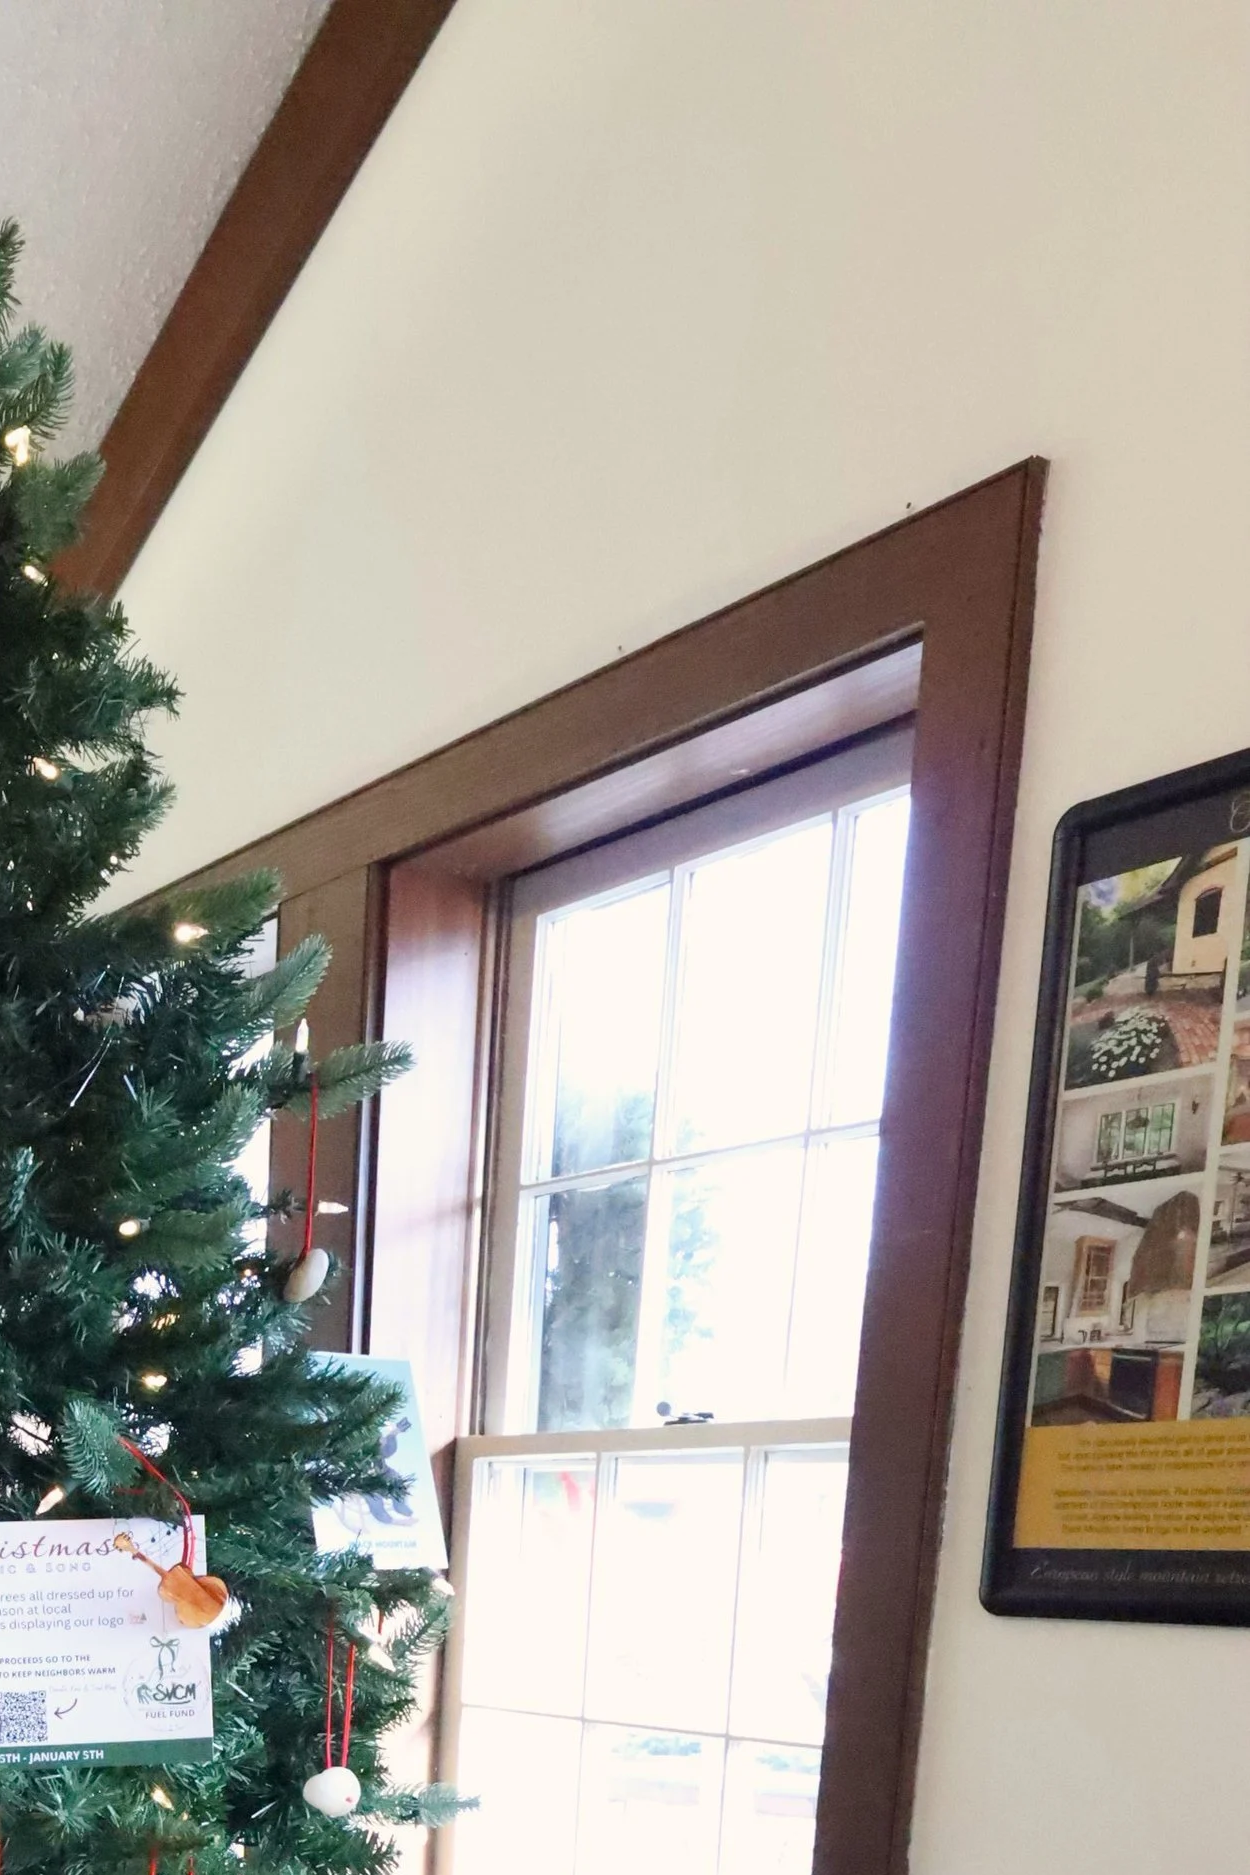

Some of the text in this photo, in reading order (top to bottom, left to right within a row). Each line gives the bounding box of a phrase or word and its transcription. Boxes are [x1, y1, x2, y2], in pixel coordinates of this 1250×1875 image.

[45, 1562, 91, 1573] SONG
[28, 1590, 43, 1602] all
[46, 1589, 95, 1601] dressed
[98, 1589, 115, 1602] up
[117, 1587, 134, 1598] for
[27, 1605, 39, 1616] at
[42, 1603, 72, 1615] local
[9, 1617, 71, 1633] displaying
[73, 1618, 94, 1628] our
[98, 1615, 124, 1629] logo
[0, 1656, 43, 1665] PROCEEDS
[45, 1655, 59, 1664] GO
[61, 1654, 73, 1663] TO
[75, 1654, 91, 1663] THE
[11, 1669, 32, 1678] KEEP
[34, 1667, 86, 1677] NEIGHBORS
[87, 1666, 116, 1676] WARM
[152, 1682, 197, 1701] SVCM
[145, 1709, 196, 1719] FUEL FUND
[0, 1752, 21, 1764] 5TH
[28, 1750, 80, 1765] JANUARY
[82, 1749, 104, 1761] 5TH
